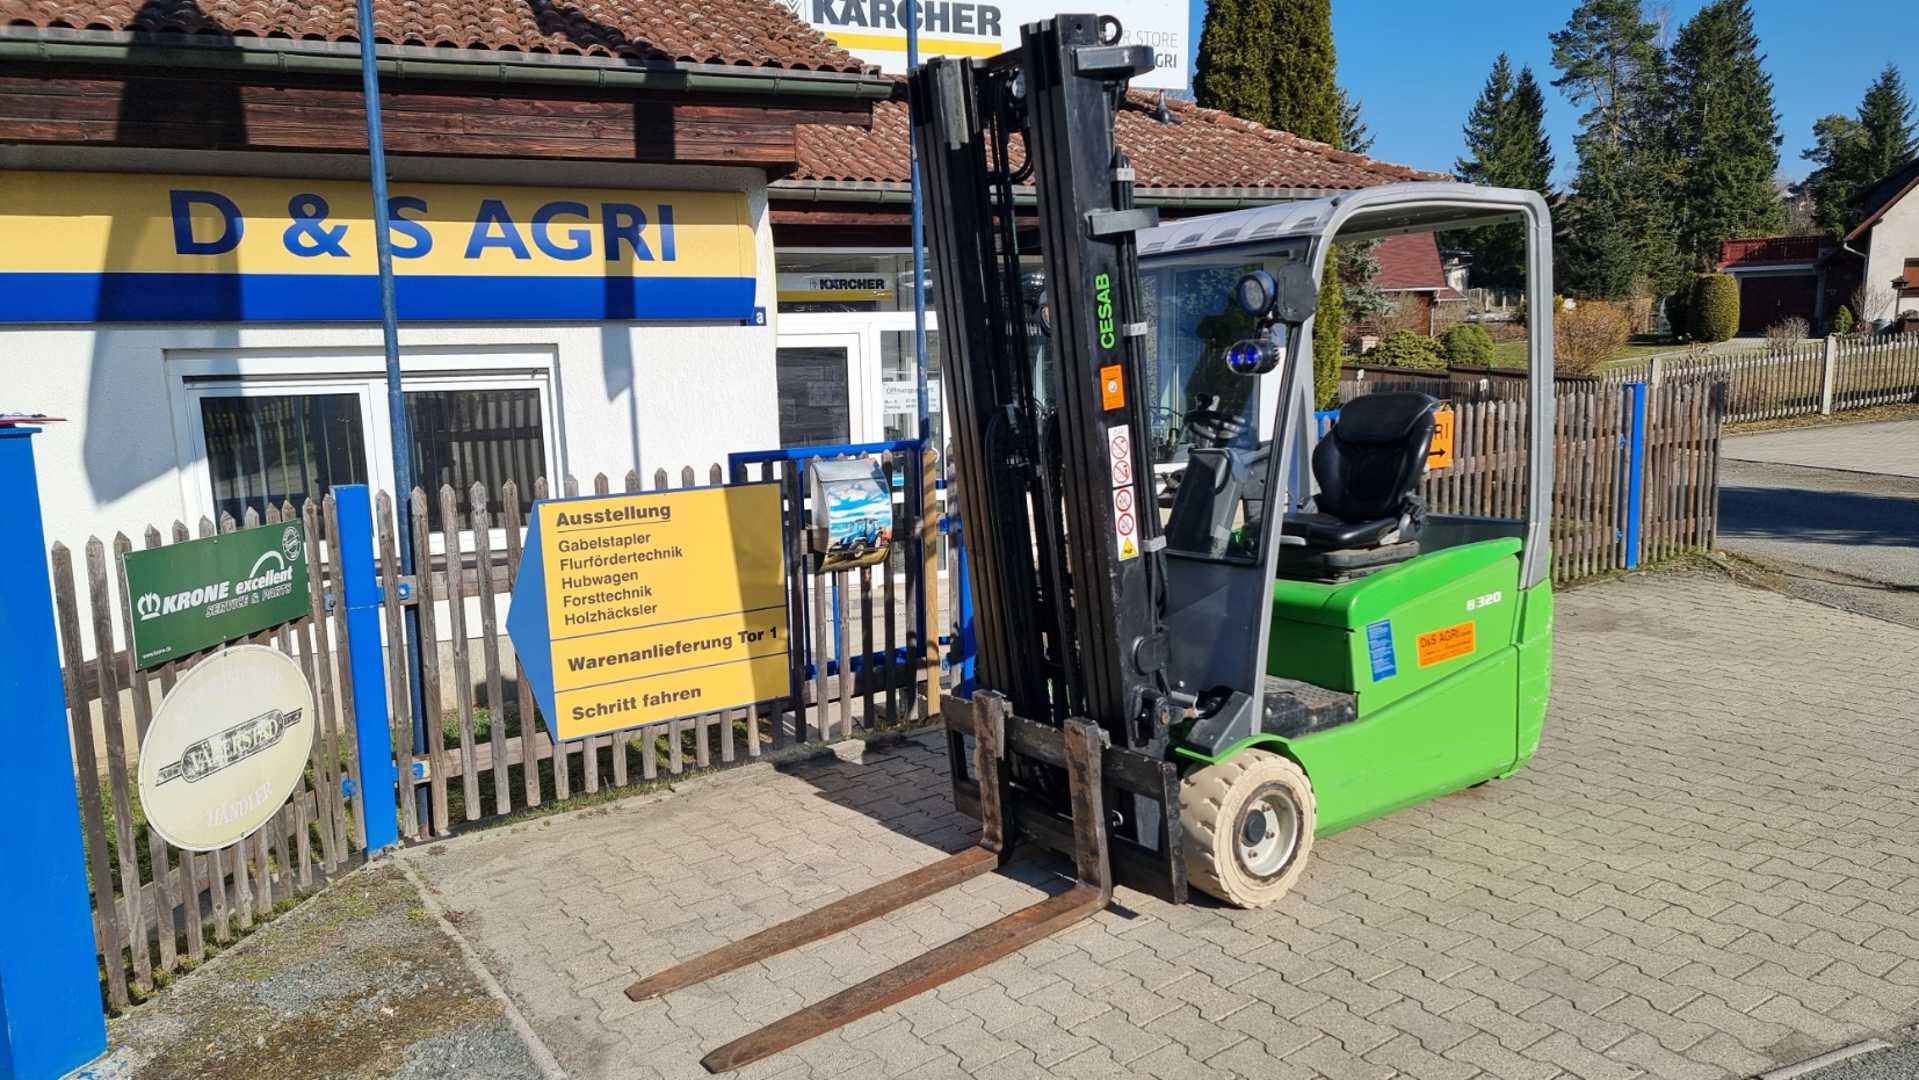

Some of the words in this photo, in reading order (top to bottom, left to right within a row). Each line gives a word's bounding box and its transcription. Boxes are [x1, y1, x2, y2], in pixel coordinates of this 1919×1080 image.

[1136, 30, 1178, 48] STORE
[1154, 52, 1177, 68] GRI
[168, 189, 244, 255] D
[283, 193, 351, 258] &
[387, 196, 433, 259] S
[464, 199, 676, 262] AGRI
[819, 278, 885, 290] KÄRCHER
[1095, 273, 1115, 349] CESAB
[1434, 423, 1448, 440] RI
[556, 504, 671, 527] Ausstellung
[558, 532, 651, 553] Gabelstapler
[560, 546, 683, 572] Flurfördertechnik
[162, 581, 230, 615] KRONE
[235, 565, 293, 595] excellent
[561, 570, 639, 590] Hubwagen
[205, 594, 249, 618] SERVICE
[251, 592, 259, 604] &
[261, 582, 292, 602] PARTS
[563, 586, 653, 608] Forsttechnik
[564, 603, 658, 626] Holzhäcksler
[568, 635, 732, 672] Warenanlieferung
[737, 629, 764, 645] Tor
[770, 626, 777, 639] 1
[572, 696, 637, 721] Schritt
[642, 686, 702, 708] fahren
